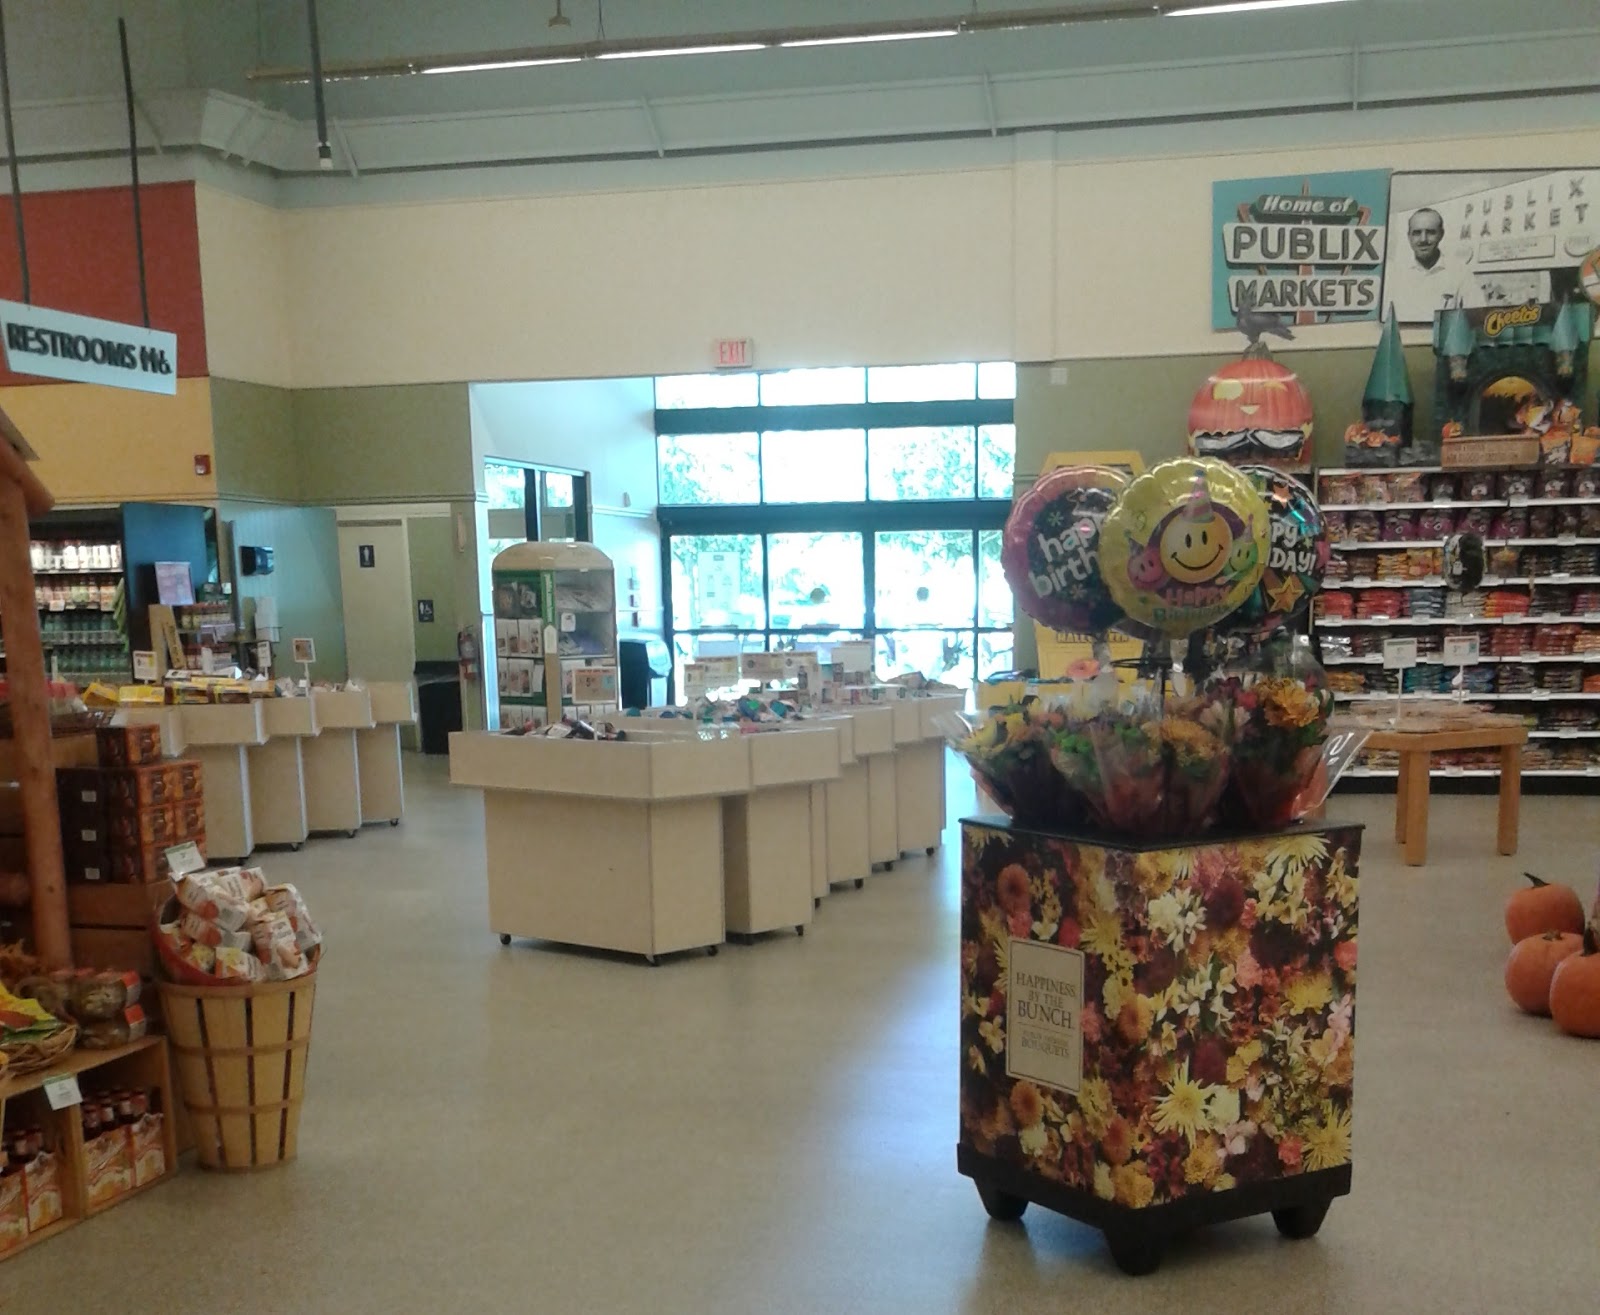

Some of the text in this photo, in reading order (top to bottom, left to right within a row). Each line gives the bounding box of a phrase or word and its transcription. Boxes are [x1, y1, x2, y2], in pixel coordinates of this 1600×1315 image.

[1262, 194, 1351, 213] Home of
[1463, 176, 1585, 220] PUBLIX
[1459, 203, 1590, 241] MARKET
[1232, 225, 1382, 262] PUBLIX
[1235, 278, 1375, 308] MARKETS
[1485, 304, 1540, 337] Cheetos
[6, 322, 138, 371] RESTROOMS
[719, 339, 747, 364] EXIT
[1037, 513, 1102, 562] hap
[1028, 546, 1098, 599] birth
[1269, 547, 1317, 576] DAY!
[1016, 971, 1076, 998] HAPPINESS
[1028, 990, 1064, 1009] BY THE
[1017, 999, 1072, 1029] BUNCH
